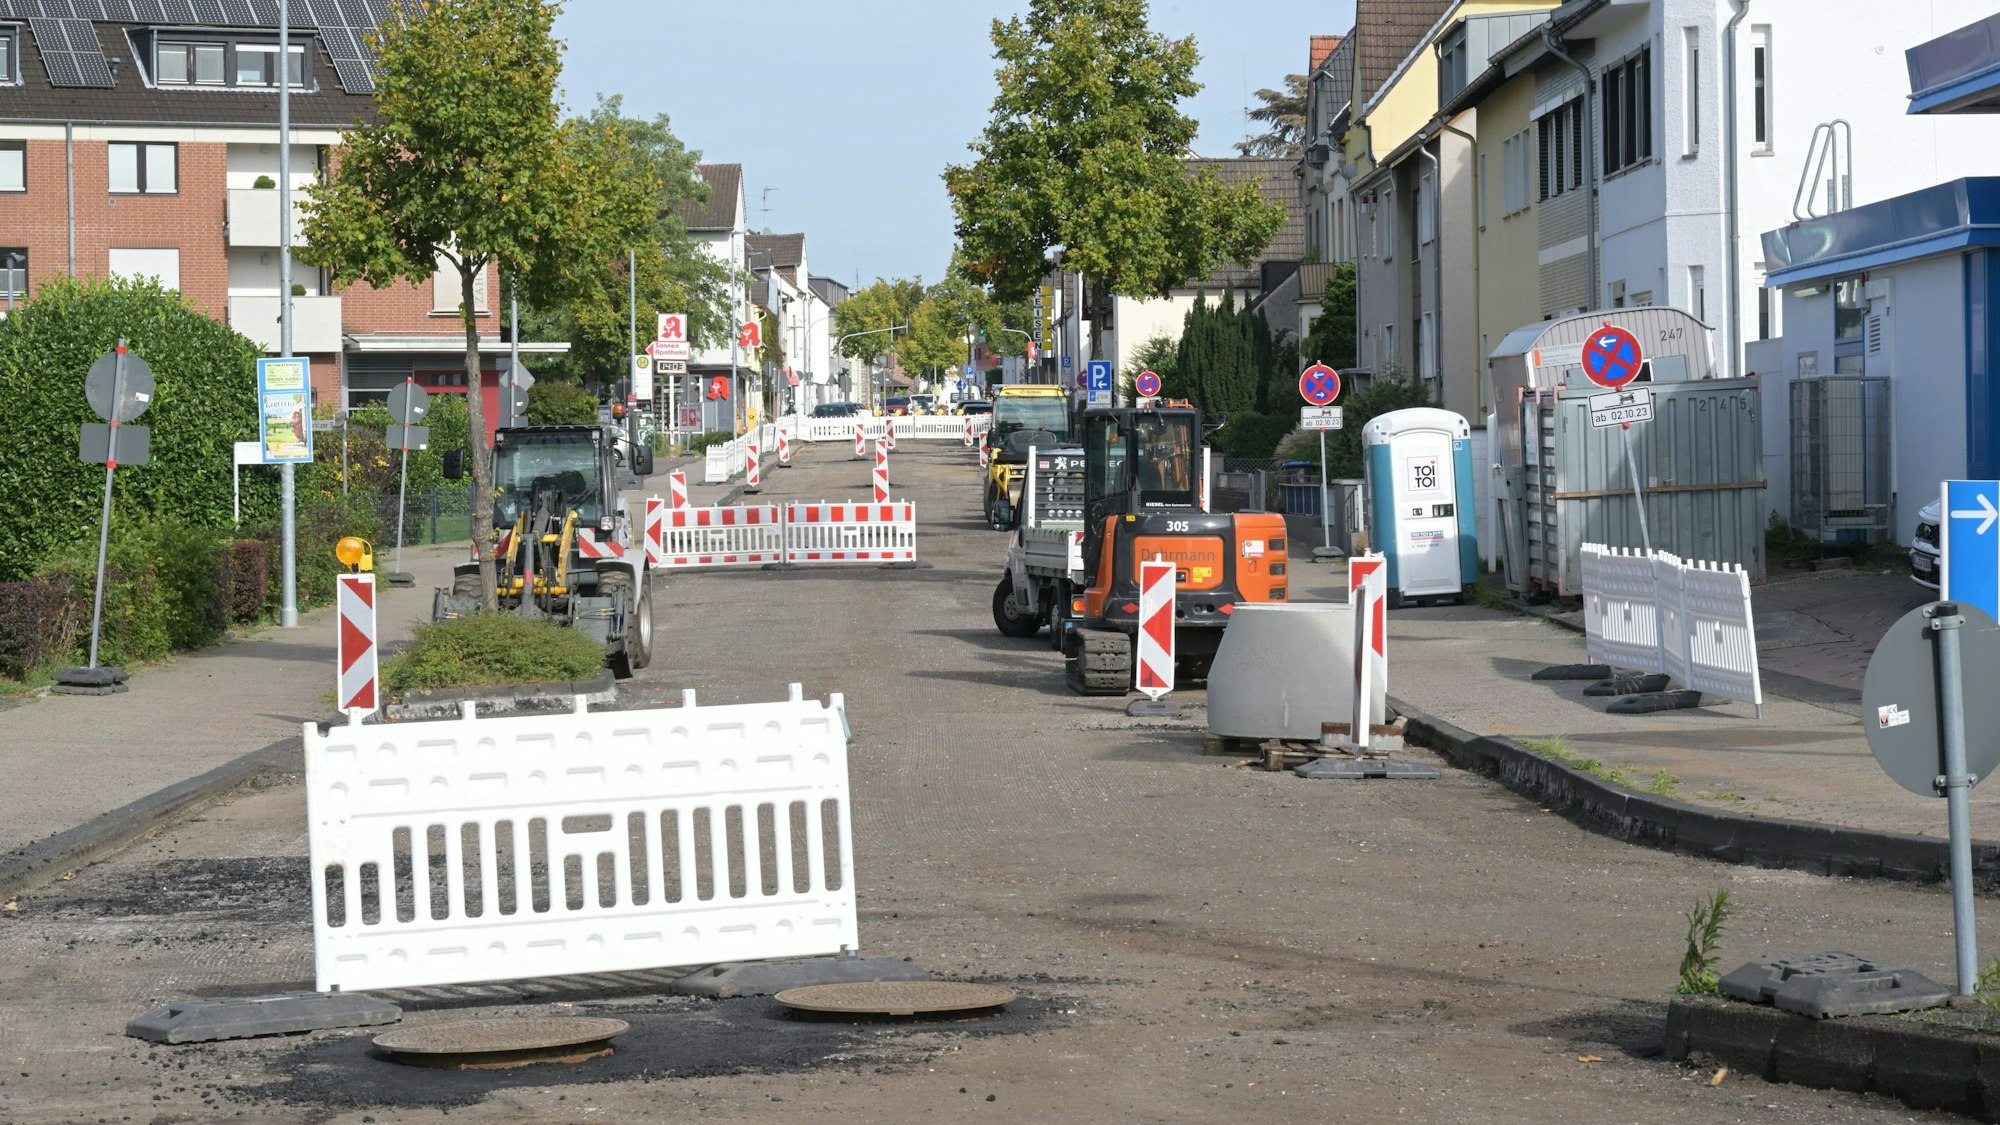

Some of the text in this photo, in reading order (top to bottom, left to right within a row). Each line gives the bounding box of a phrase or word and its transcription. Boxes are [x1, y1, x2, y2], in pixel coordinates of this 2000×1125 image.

[1034, 286, 1042, 350] REISEN
[1660, 328, 1683, 341] 247
[1596, 408, 1648, 422] ab 02.10.23
[1414, 465, 1435, 476] TOI
[1415, 476, 1436, 488] TOI
[1166, 520, 1189, 532] 305
